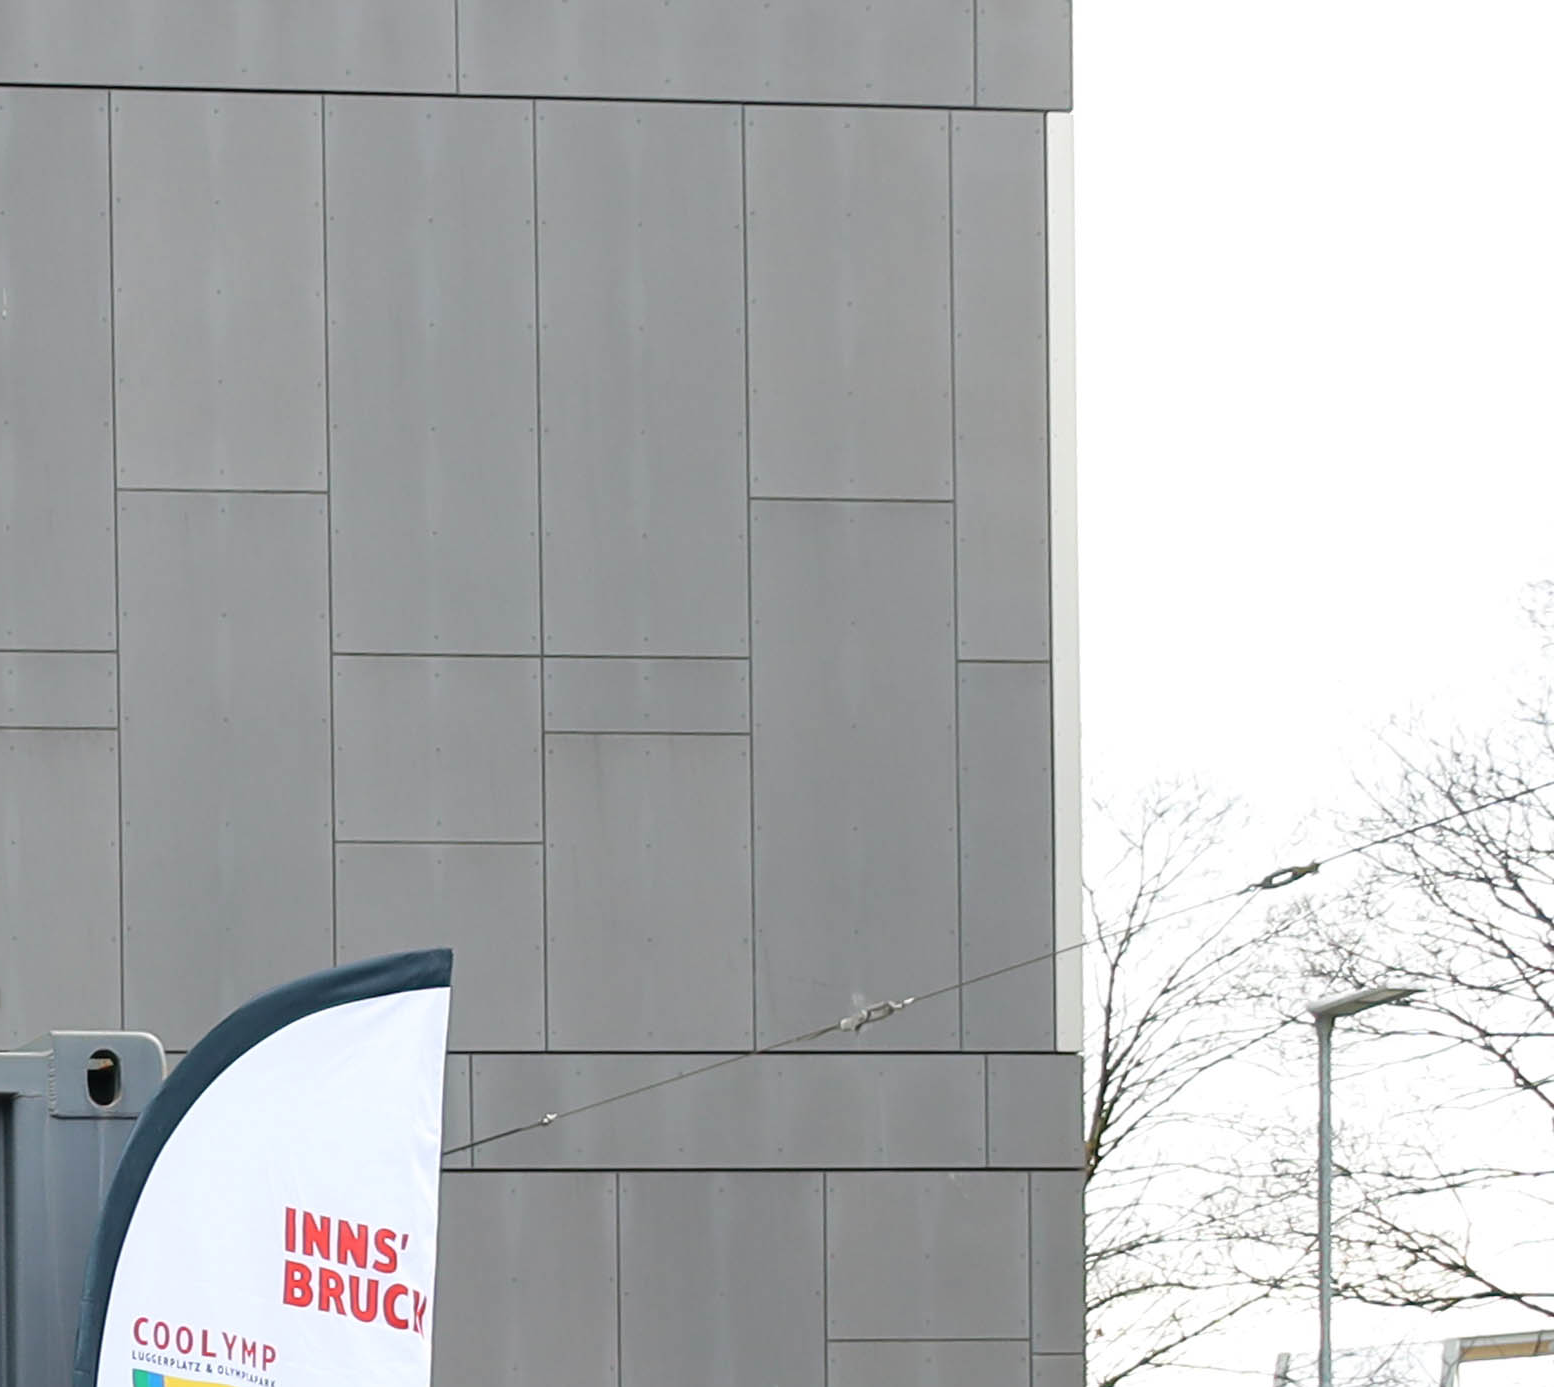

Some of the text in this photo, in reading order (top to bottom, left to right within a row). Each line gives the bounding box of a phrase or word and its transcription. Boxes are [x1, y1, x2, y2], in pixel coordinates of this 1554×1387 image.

[285, 1206, 409, 1274] INNS'
[283, 1259, 427, 1340] BRUCK
[131, 1350, 201, 1372] LUGGERPLATZ
[206, 1363, 213, 1374] &
[133, 1316, 276, 1372] COOLYMP
